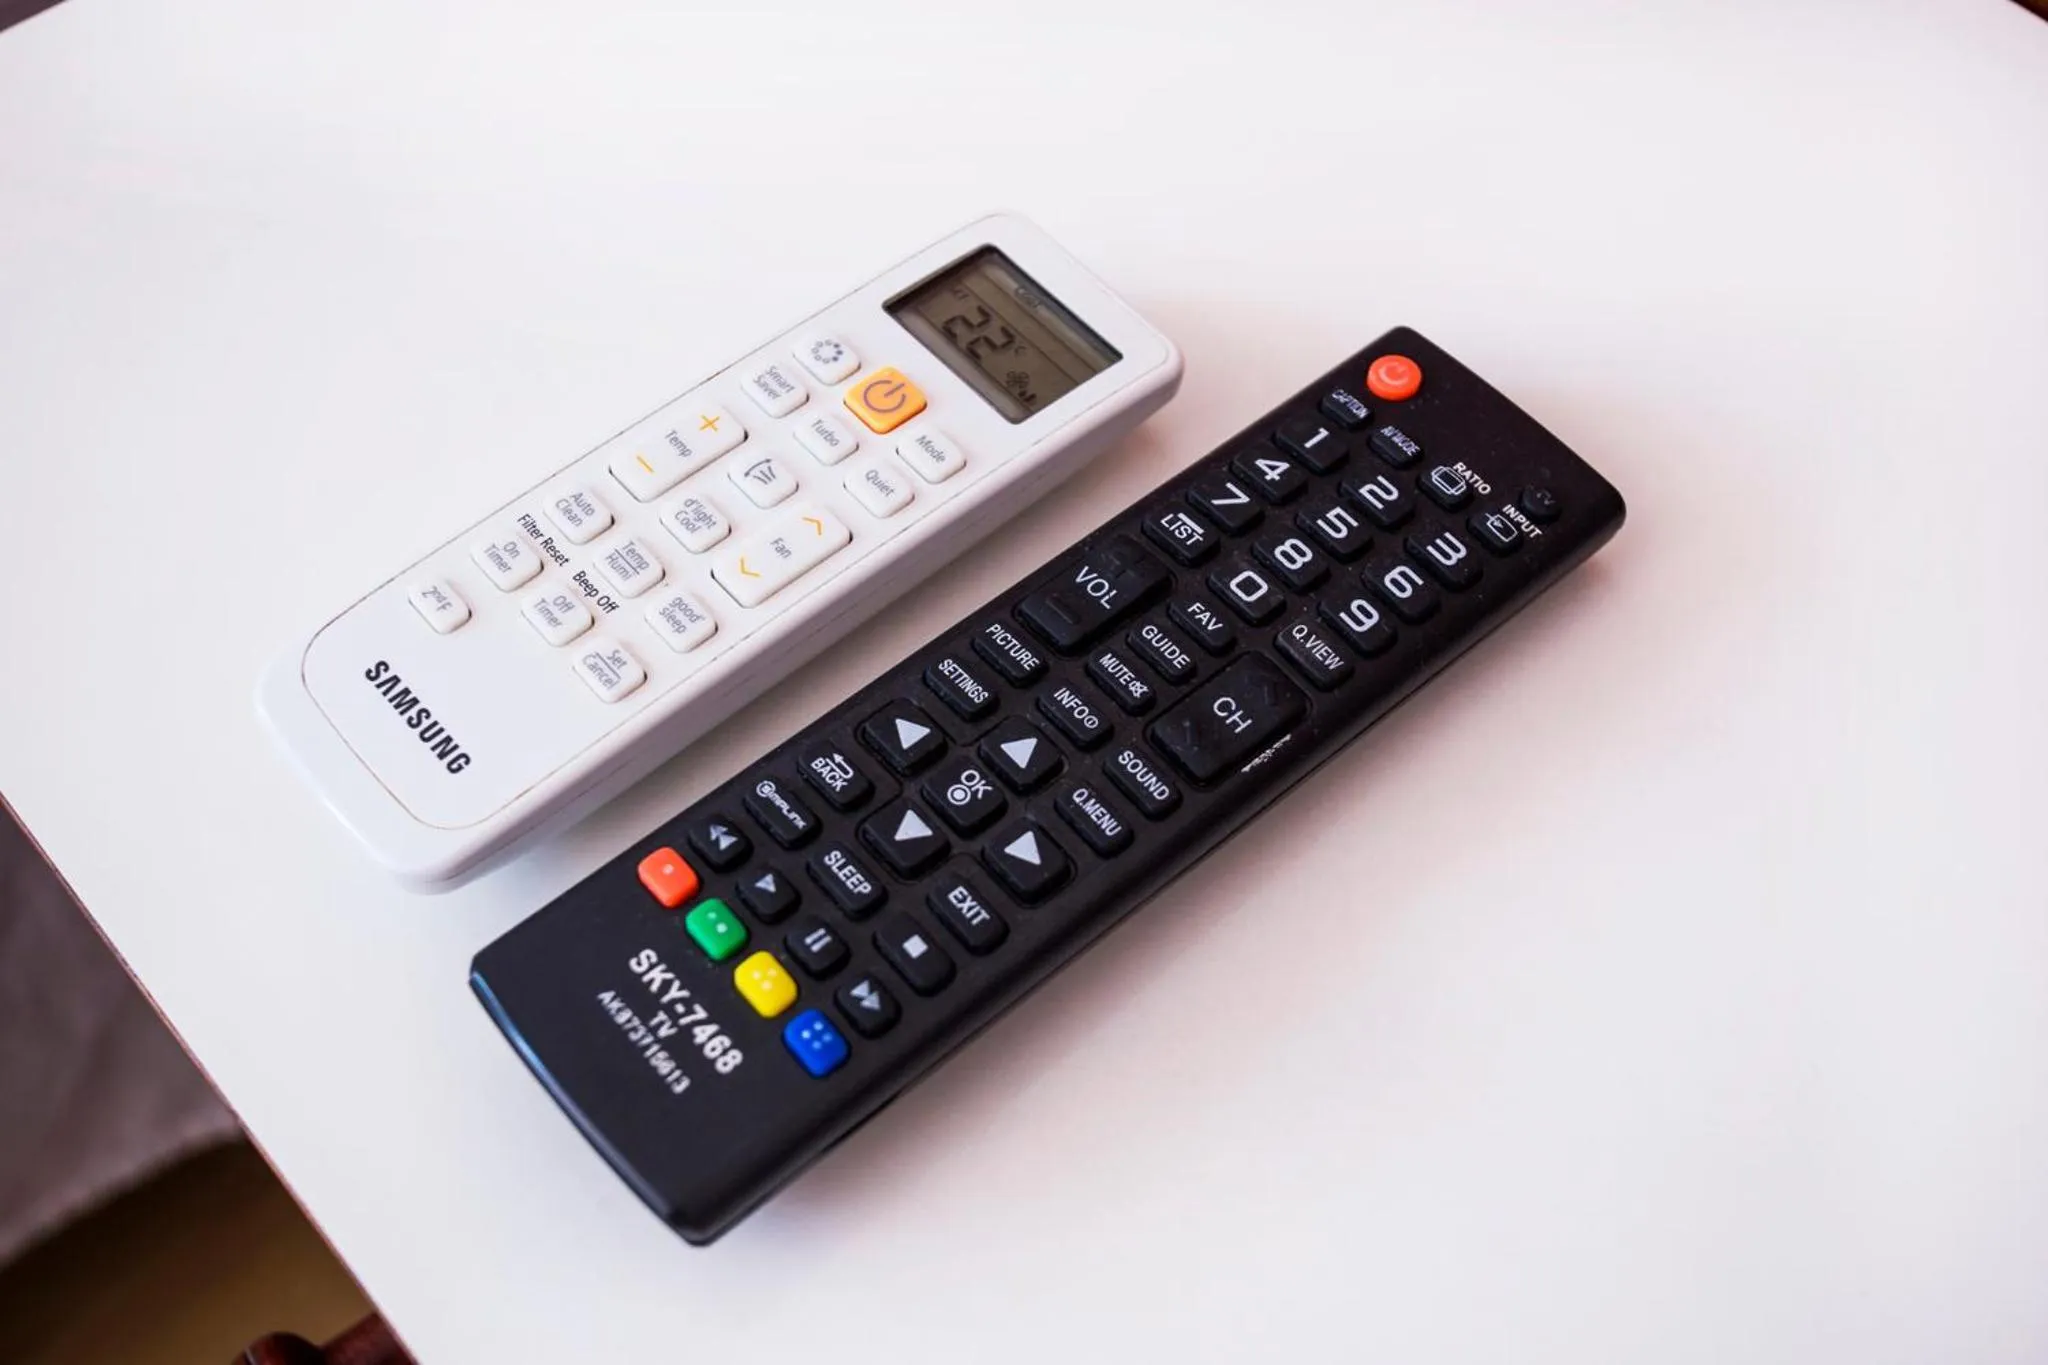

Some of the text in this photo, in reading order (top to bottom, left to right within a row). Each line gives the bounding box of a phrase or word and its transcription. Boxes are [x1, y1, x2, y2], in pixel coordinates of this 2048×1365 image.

[752, 377, 782, 401] Saver
[764, 365, 796, 395] Smart
[664, 429, 693, 459] Temp
[811, 419, 840, 448] Turbo
[915, 434, 947, 464] Mode
[1303, 427, 1330, 449] 1
[864, 469, 896, 498] Quiet
[1254, 458, 1291, 481] 4
[1452, 461, 1492, 495] RATIO
[569, 491, 596, 516] Auto
[1210, 482, 1250, 505] 7
[1358, 475, 1399, 509] 2
[555, 499, 584, 528] Clean
[674, 511, 699, 536] Cool
[1316, 506, 1359, 539] 5
[1502, 504, 1543, 538] INPUT
[517, 513, 570, 568] Filter Reset
[1160, 513, 1204, 547] LIST
[484, 543, 512, 575] Timer
[503, 540, 521, 560] On
[622, 540, 650, 572] Temp
[769, 537, 792, 560] Fan
[1273, 538, 1313, 570] 8
[1426, 531, 1467, 566] 3
[604, 553, 635, 583] Humi
[1383, 565, 1424, 599] 6
[572, 569, 620, 615] Beep Off
[1075, 565, 1118, 610] VOL
[1229, 570, 1269, 602] 0
[532, 598, 564, 629] Timer
[552, 594, 575, 614] Off
[1188, 602, 1224, 632] FAV
[1339, 599, 1380, 633] 9
[659, 607, 686, 634] sleep
[607, 650, 627, 670] Set
[985, 623, 1040, 672] PICTURE
[1141, 624, 1190, 669] GUIDE
[1292, 624, 1345, 670] Q.VIEW
[582, 653, 618, 690] Cancel
[938, 658, 989, 705] SETTINGS
[1099, 653, 1136, 688] MUTE
[365, 660, 471, 775] SAMSUNG
[1212, 696, 1253, 735] CH
[810, 757, 848, 793] BACK
[960, 769, 993, 801] OK
[1118, 750, 1170, 802] SOUND
[1072, 788, 1122, 837] Q.MENU
[824, 850, 872, 896] SLEEP
[948, 886, 990, 927] EXIT
[628, 949, 744, 1075] SKY-7468
[649, 1010, 678, 1039] TV
